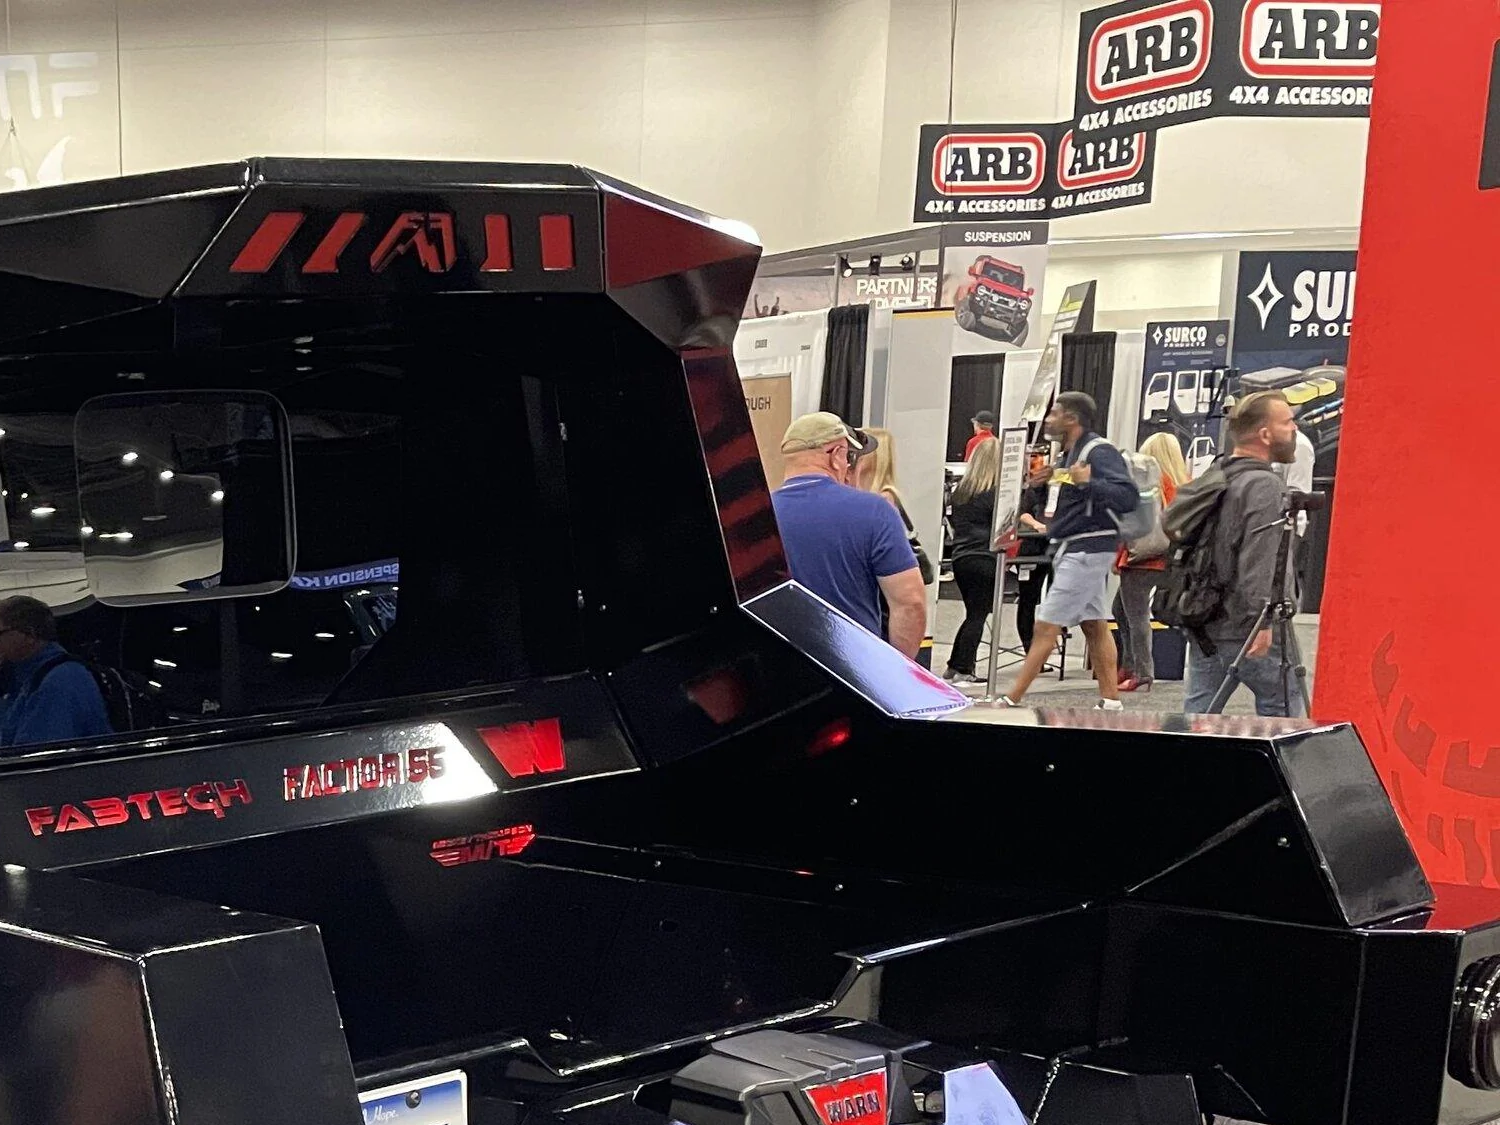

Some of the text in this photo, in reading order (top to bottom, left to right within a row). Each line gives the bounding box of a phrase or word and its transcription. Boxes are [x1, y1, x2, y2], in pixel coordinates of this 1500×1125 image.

[1101, 16, 1198, 86] ARB
[1259, 8, 1380, 60] ARB
[1112, 88, 1213, 126] ACCESSORIES
[945, 147, 1033, 181] ARB
[1067, 135, 1134, 176] ARB
[958, 198, 1046, 213] ACCESSORIES
[1075, 182, 1145, 206] ACCESSORIES
[964, 230, 1031, 243] SUSPENSION
[856, 277, 938, 296] PARTNRS
[1164, 326, 1208, 343] SURCO
[283, 752, 405, 801] FACTOR
[24, 778, 252, 836] FABTECH
[824, 1090, 881, 1124] WARN
